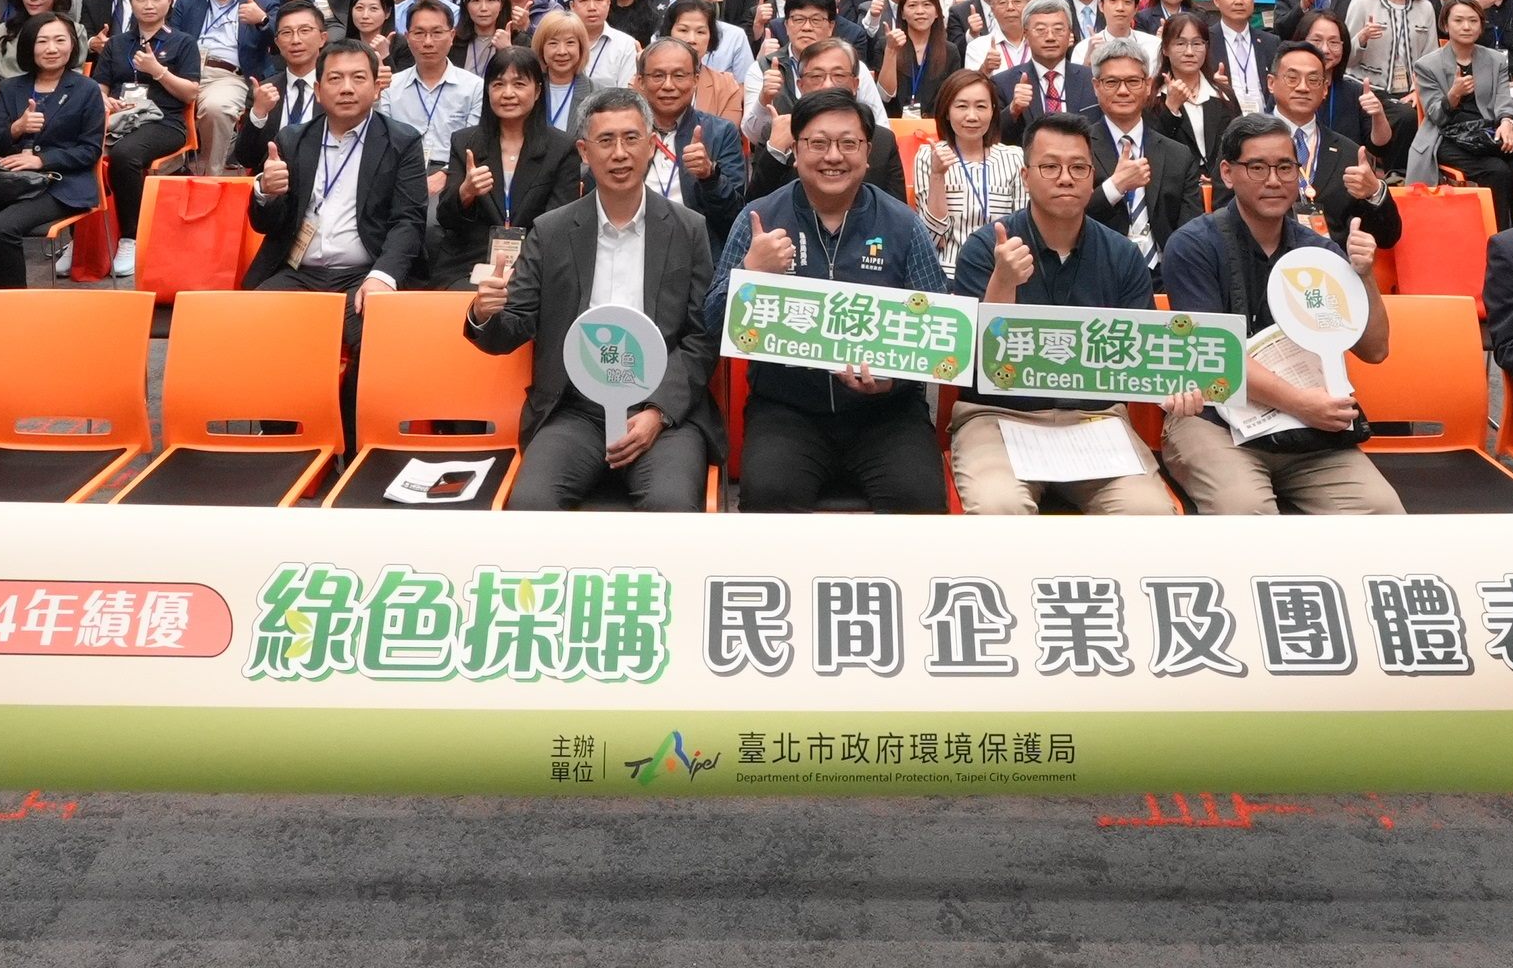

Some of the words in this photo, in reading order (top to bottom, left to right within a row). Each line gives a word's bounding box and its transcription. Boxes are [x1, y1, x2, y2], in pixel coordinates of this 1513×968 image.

[862, 256, 884, 265] TAIPEI
[1305, 288, 1338, 310] 綠色
[741, 290, 958, 353] 淨零綠生活
[600, 345, 636, 367] 綠色
[763, 333, 822, 359] Green
[832, 341, 929, 371] Lifestyle
[995, 318, 1226, 373] 淨零綠生活
[1022, 367, 1084, 389] Green
[1095, 370, 1198, 393] Lifestyle
[243, 563, 668, 681] 綠色採購
[550, 734, 595, 759] 主辦
[737, 731, 1076, 764] 臺北市政府環境保護局
[550, 760, 595, 783] 單位
[736, 771, 802, 784] Department
[804, 771, 814, 782] of
[816, 771, 893, 782] Environmental
[895, 771, 953, 783] Protection,
[956, 771, 987, 784] Taipei
[989, 771, 1009, 784] City
[1012, 771, 1076, 782] Government
